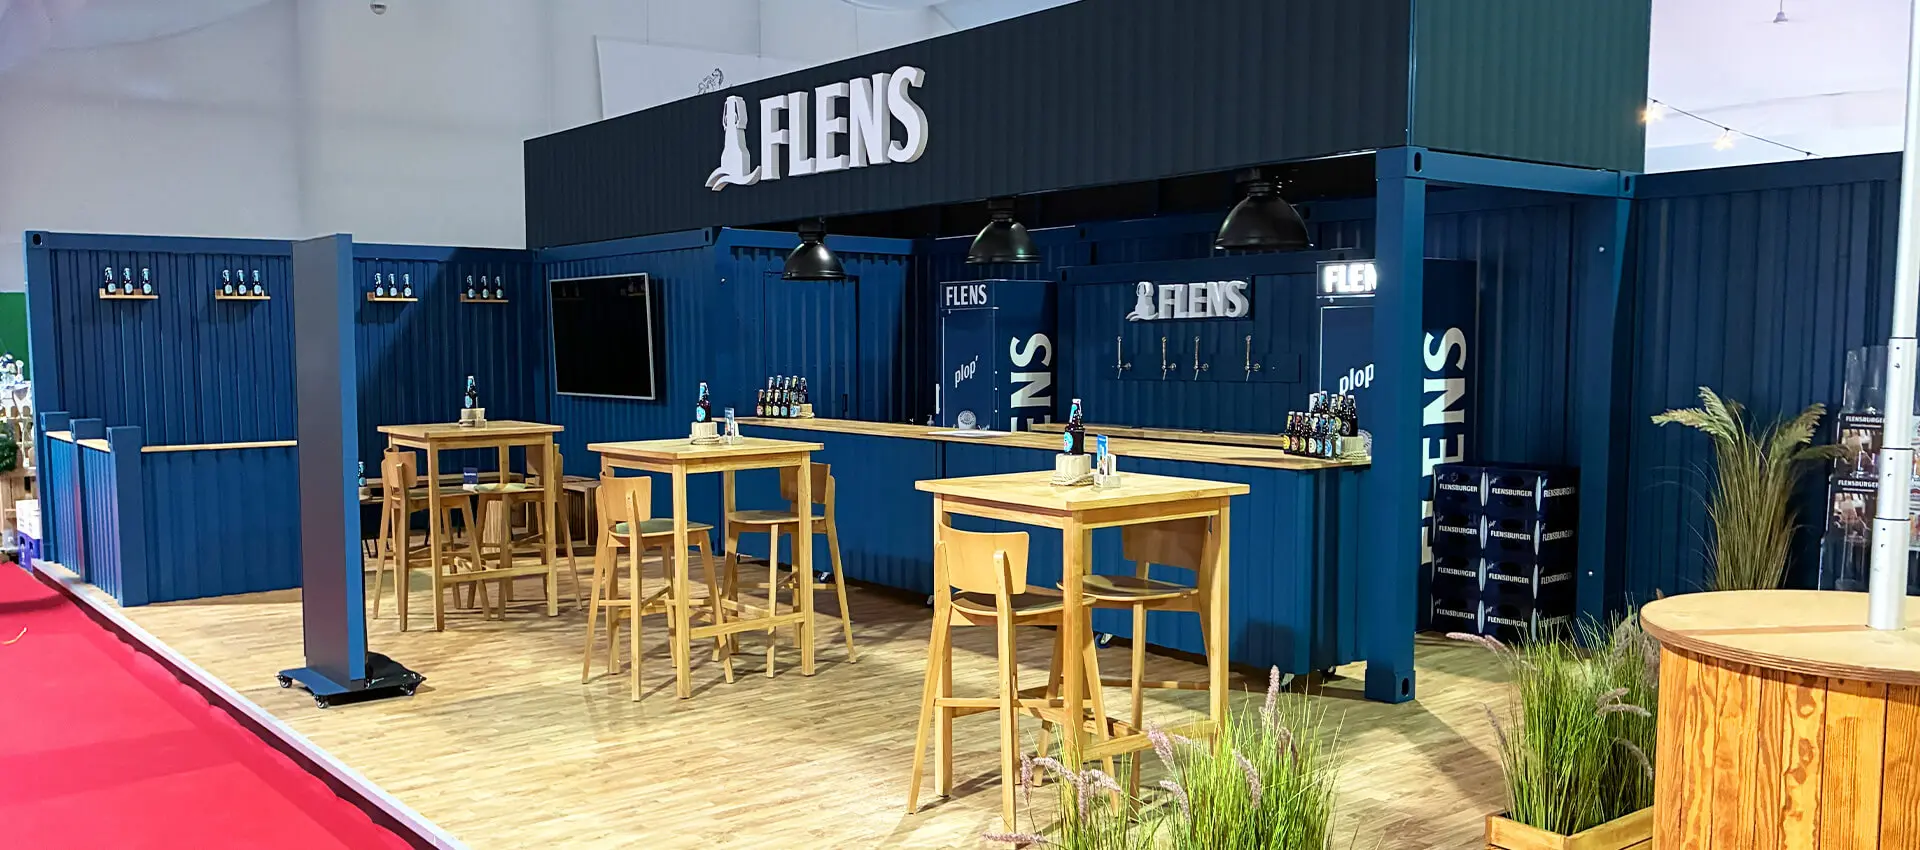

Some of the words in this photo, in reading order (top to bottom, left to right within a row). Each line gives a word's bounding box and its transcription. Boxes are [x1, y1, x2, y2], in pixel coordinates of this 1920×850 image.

[760, 66, 929, 181] FLENS
[946, 284, 988, 306] FLENS
[1158, 280, 1249, 319] FLENS
[1421, 327, 1467, 564] ENS
[1439, 483, 1478, 493] FLENSBURGER
[1491, 487, 1533, 498] FLENSBURGER
[1438, 525, 1478, 535] FLENSBURGER
[1490, 530, 1531, 541] FLENSBURGER
[1437, 567, 1476, 578] FLENSBURGER
[1488, 572, 1529, 584] FLENSBURGER
[1436, 608, 1475, 620] FLENSBURGER
